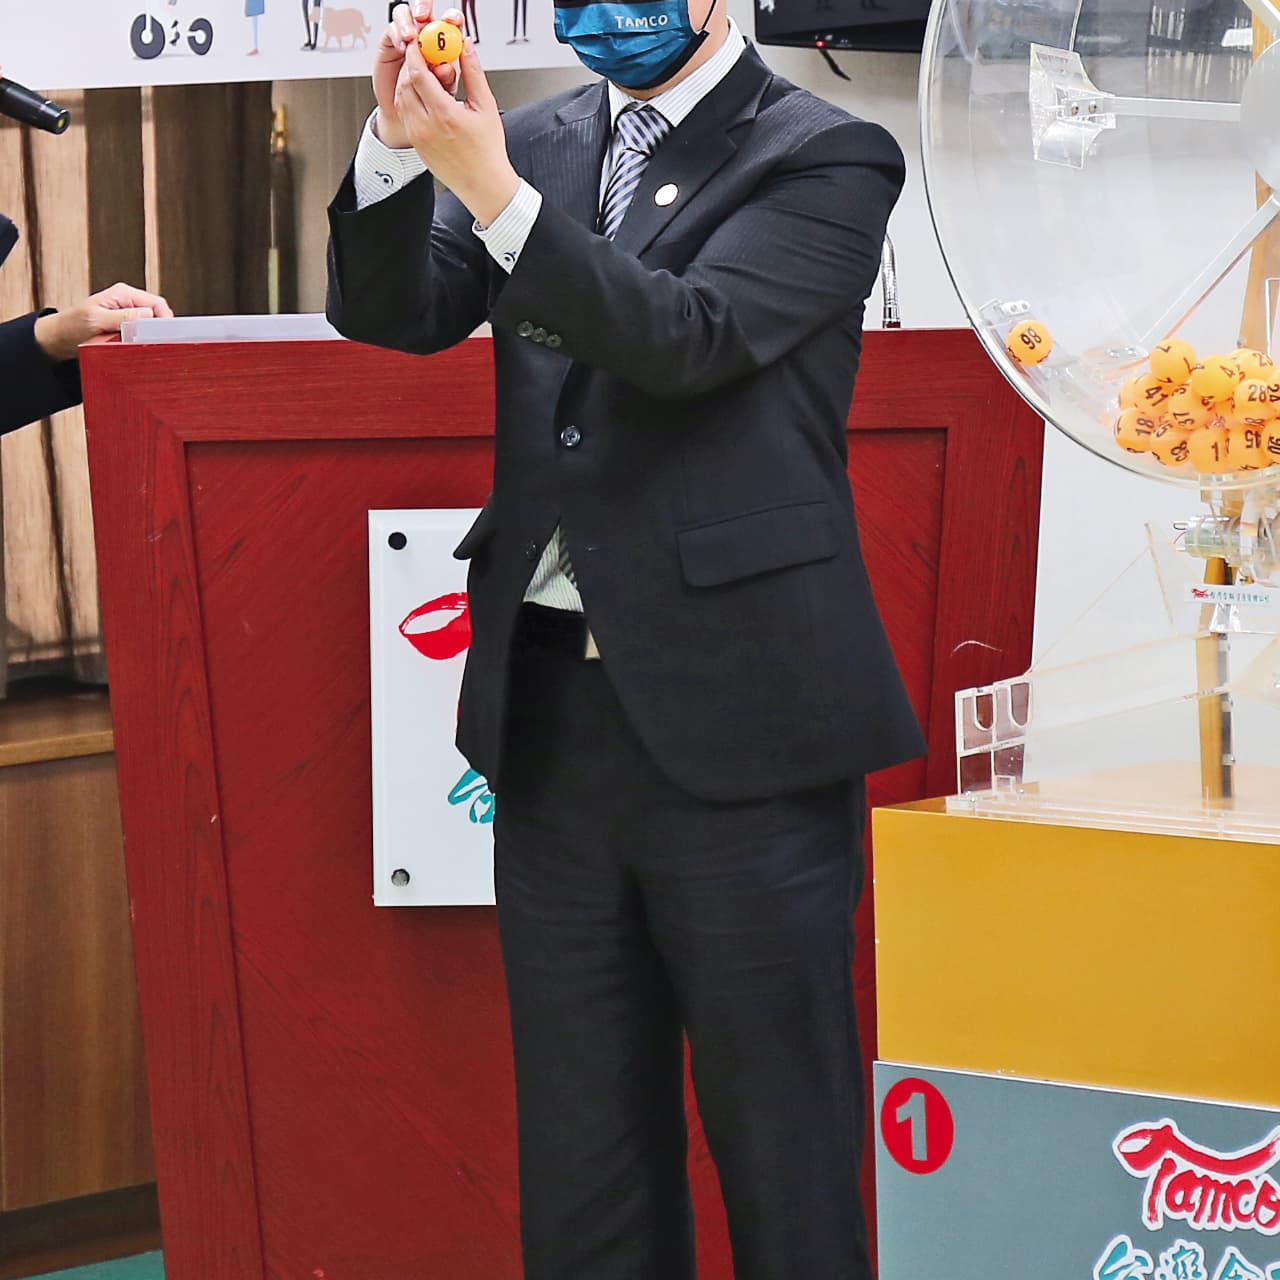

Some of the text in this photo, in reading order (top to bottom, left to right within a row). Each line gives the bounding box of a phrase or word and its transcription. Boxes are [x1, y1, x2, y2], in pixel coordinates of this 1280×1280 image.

[614, 14, 668, 29] TAMCO
[437, 31, 446, 51] 6
[1020, 326, 1042, 350] 98
[1145, 385, 1169, 408] 41
[1248, 383, 1267, 404] 28
[1135, 417, 1155, 437] 18
[1244, 428, 1262, 449] 45
[1211, 440, 1220, 462] 1
[895, 1091, 928, 1162] 1
